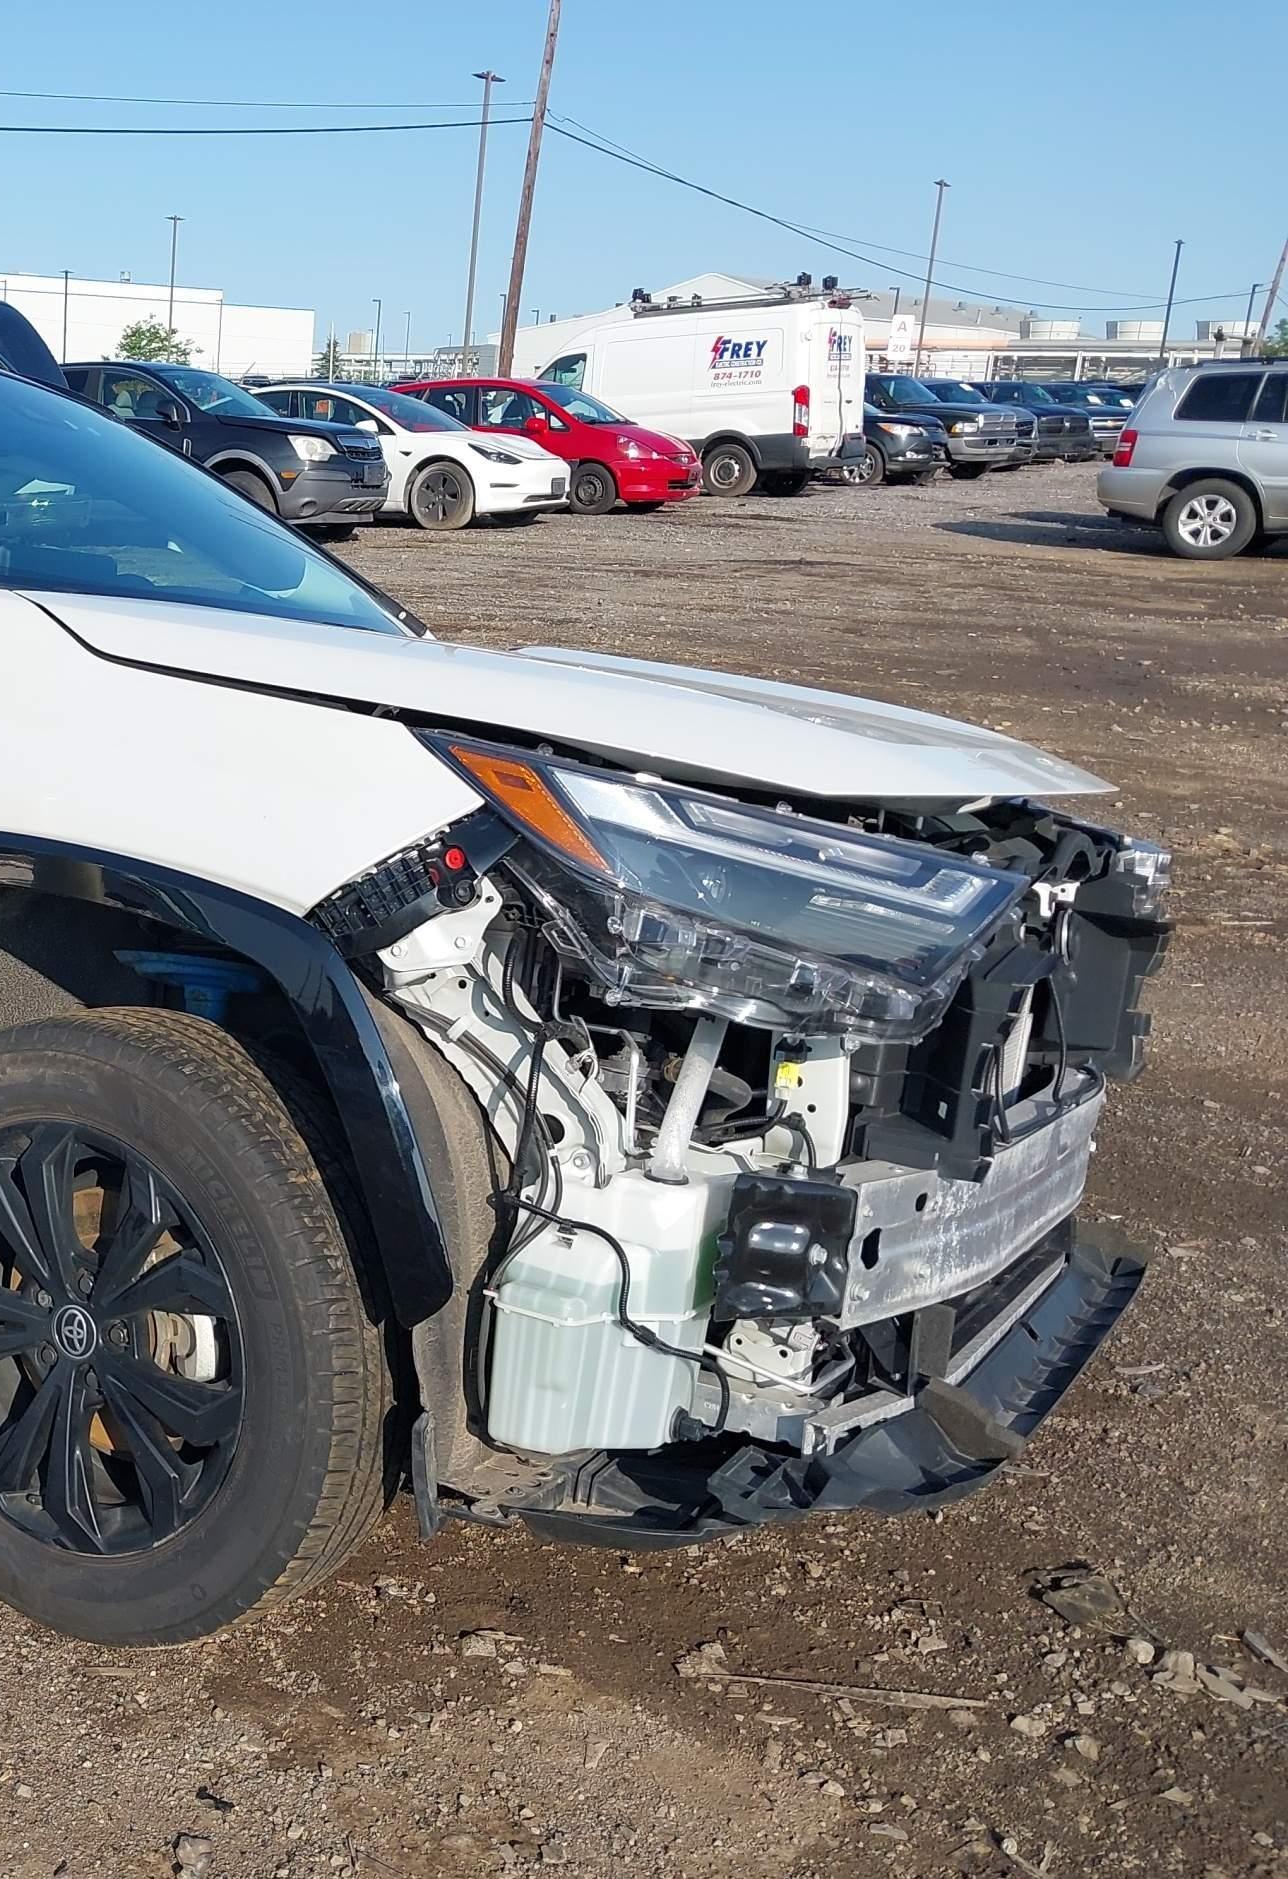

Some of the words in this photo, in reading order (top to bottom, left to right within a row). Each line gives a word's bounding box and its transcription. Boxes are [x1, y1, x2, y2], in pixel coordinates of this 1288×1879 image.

[896, 320, 908, 332] A
[718, 338, 768, 360] FREY
[892, 344, 906, 353] 20
[713, 370, 762, 380] 874-1710
